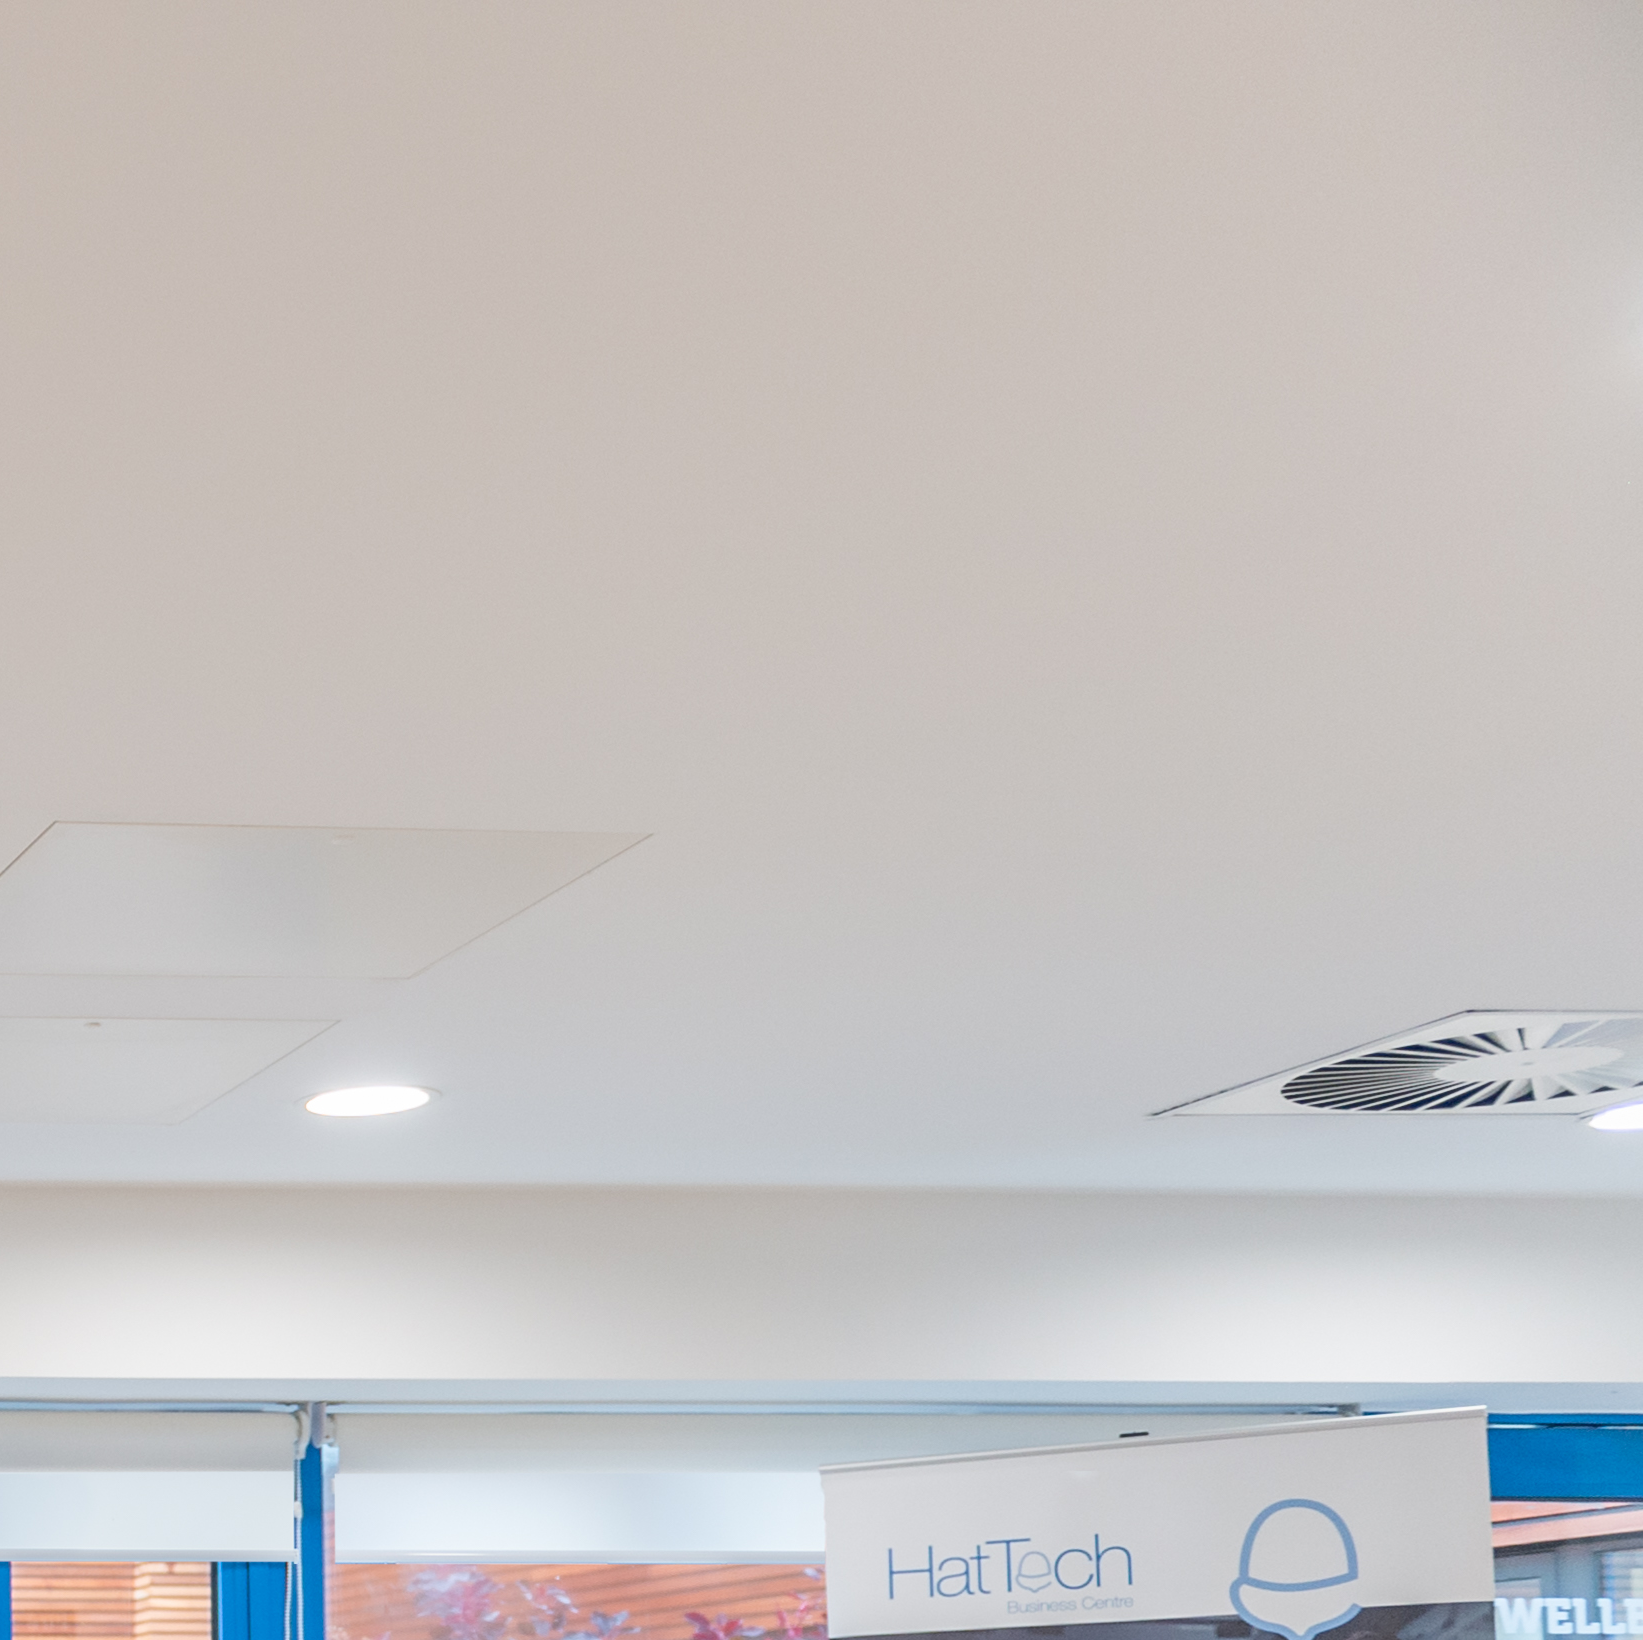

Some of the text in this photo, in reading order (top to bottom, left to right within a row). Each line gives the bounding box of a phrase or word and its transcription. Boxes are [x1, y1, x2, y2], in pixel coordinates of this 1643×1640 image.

[888, 1533, 1133, 1601] HatTech
[1007, 1596, 1133, 1614] Business Centre
